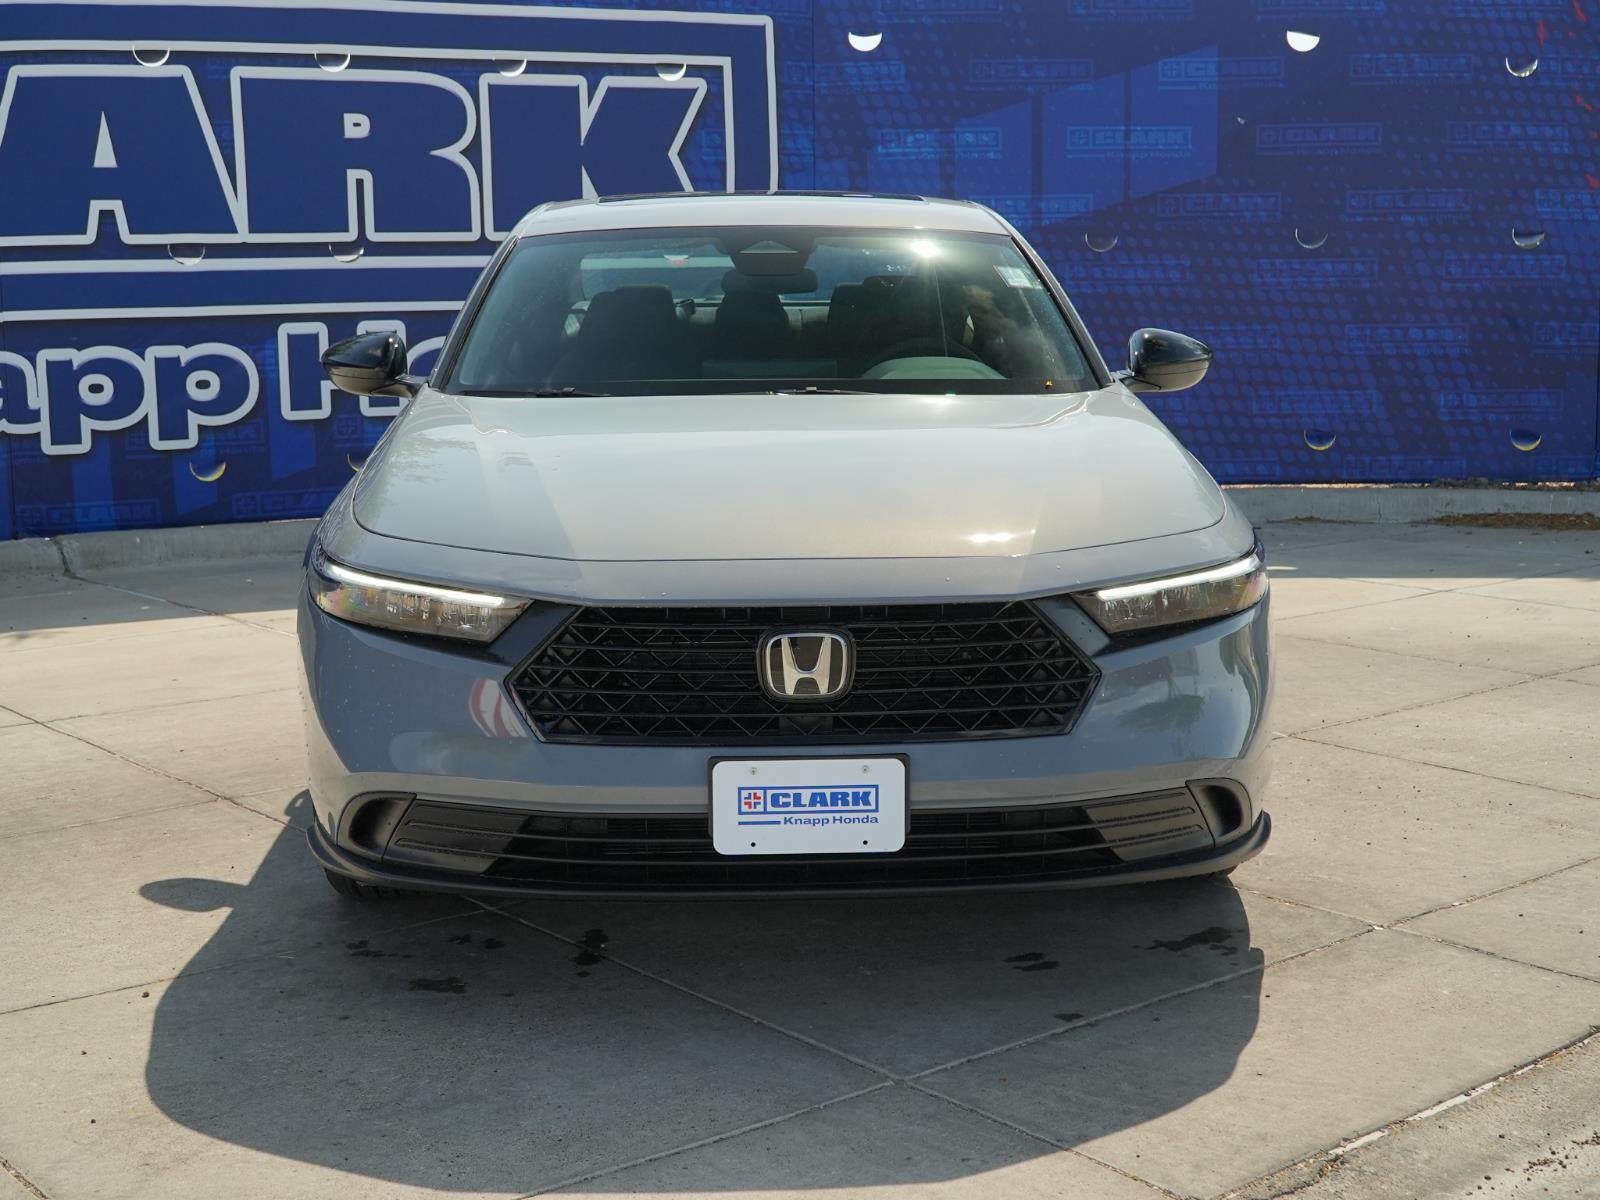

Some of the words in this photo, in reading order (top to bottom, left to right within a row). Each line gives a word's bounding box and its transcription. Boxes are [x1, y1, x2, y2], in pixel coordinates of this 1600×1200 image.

[770, 790, 872, 809] CLARK
[783, 815, 830, 827] Knapp
[832, 814, 879, 825] Honda
